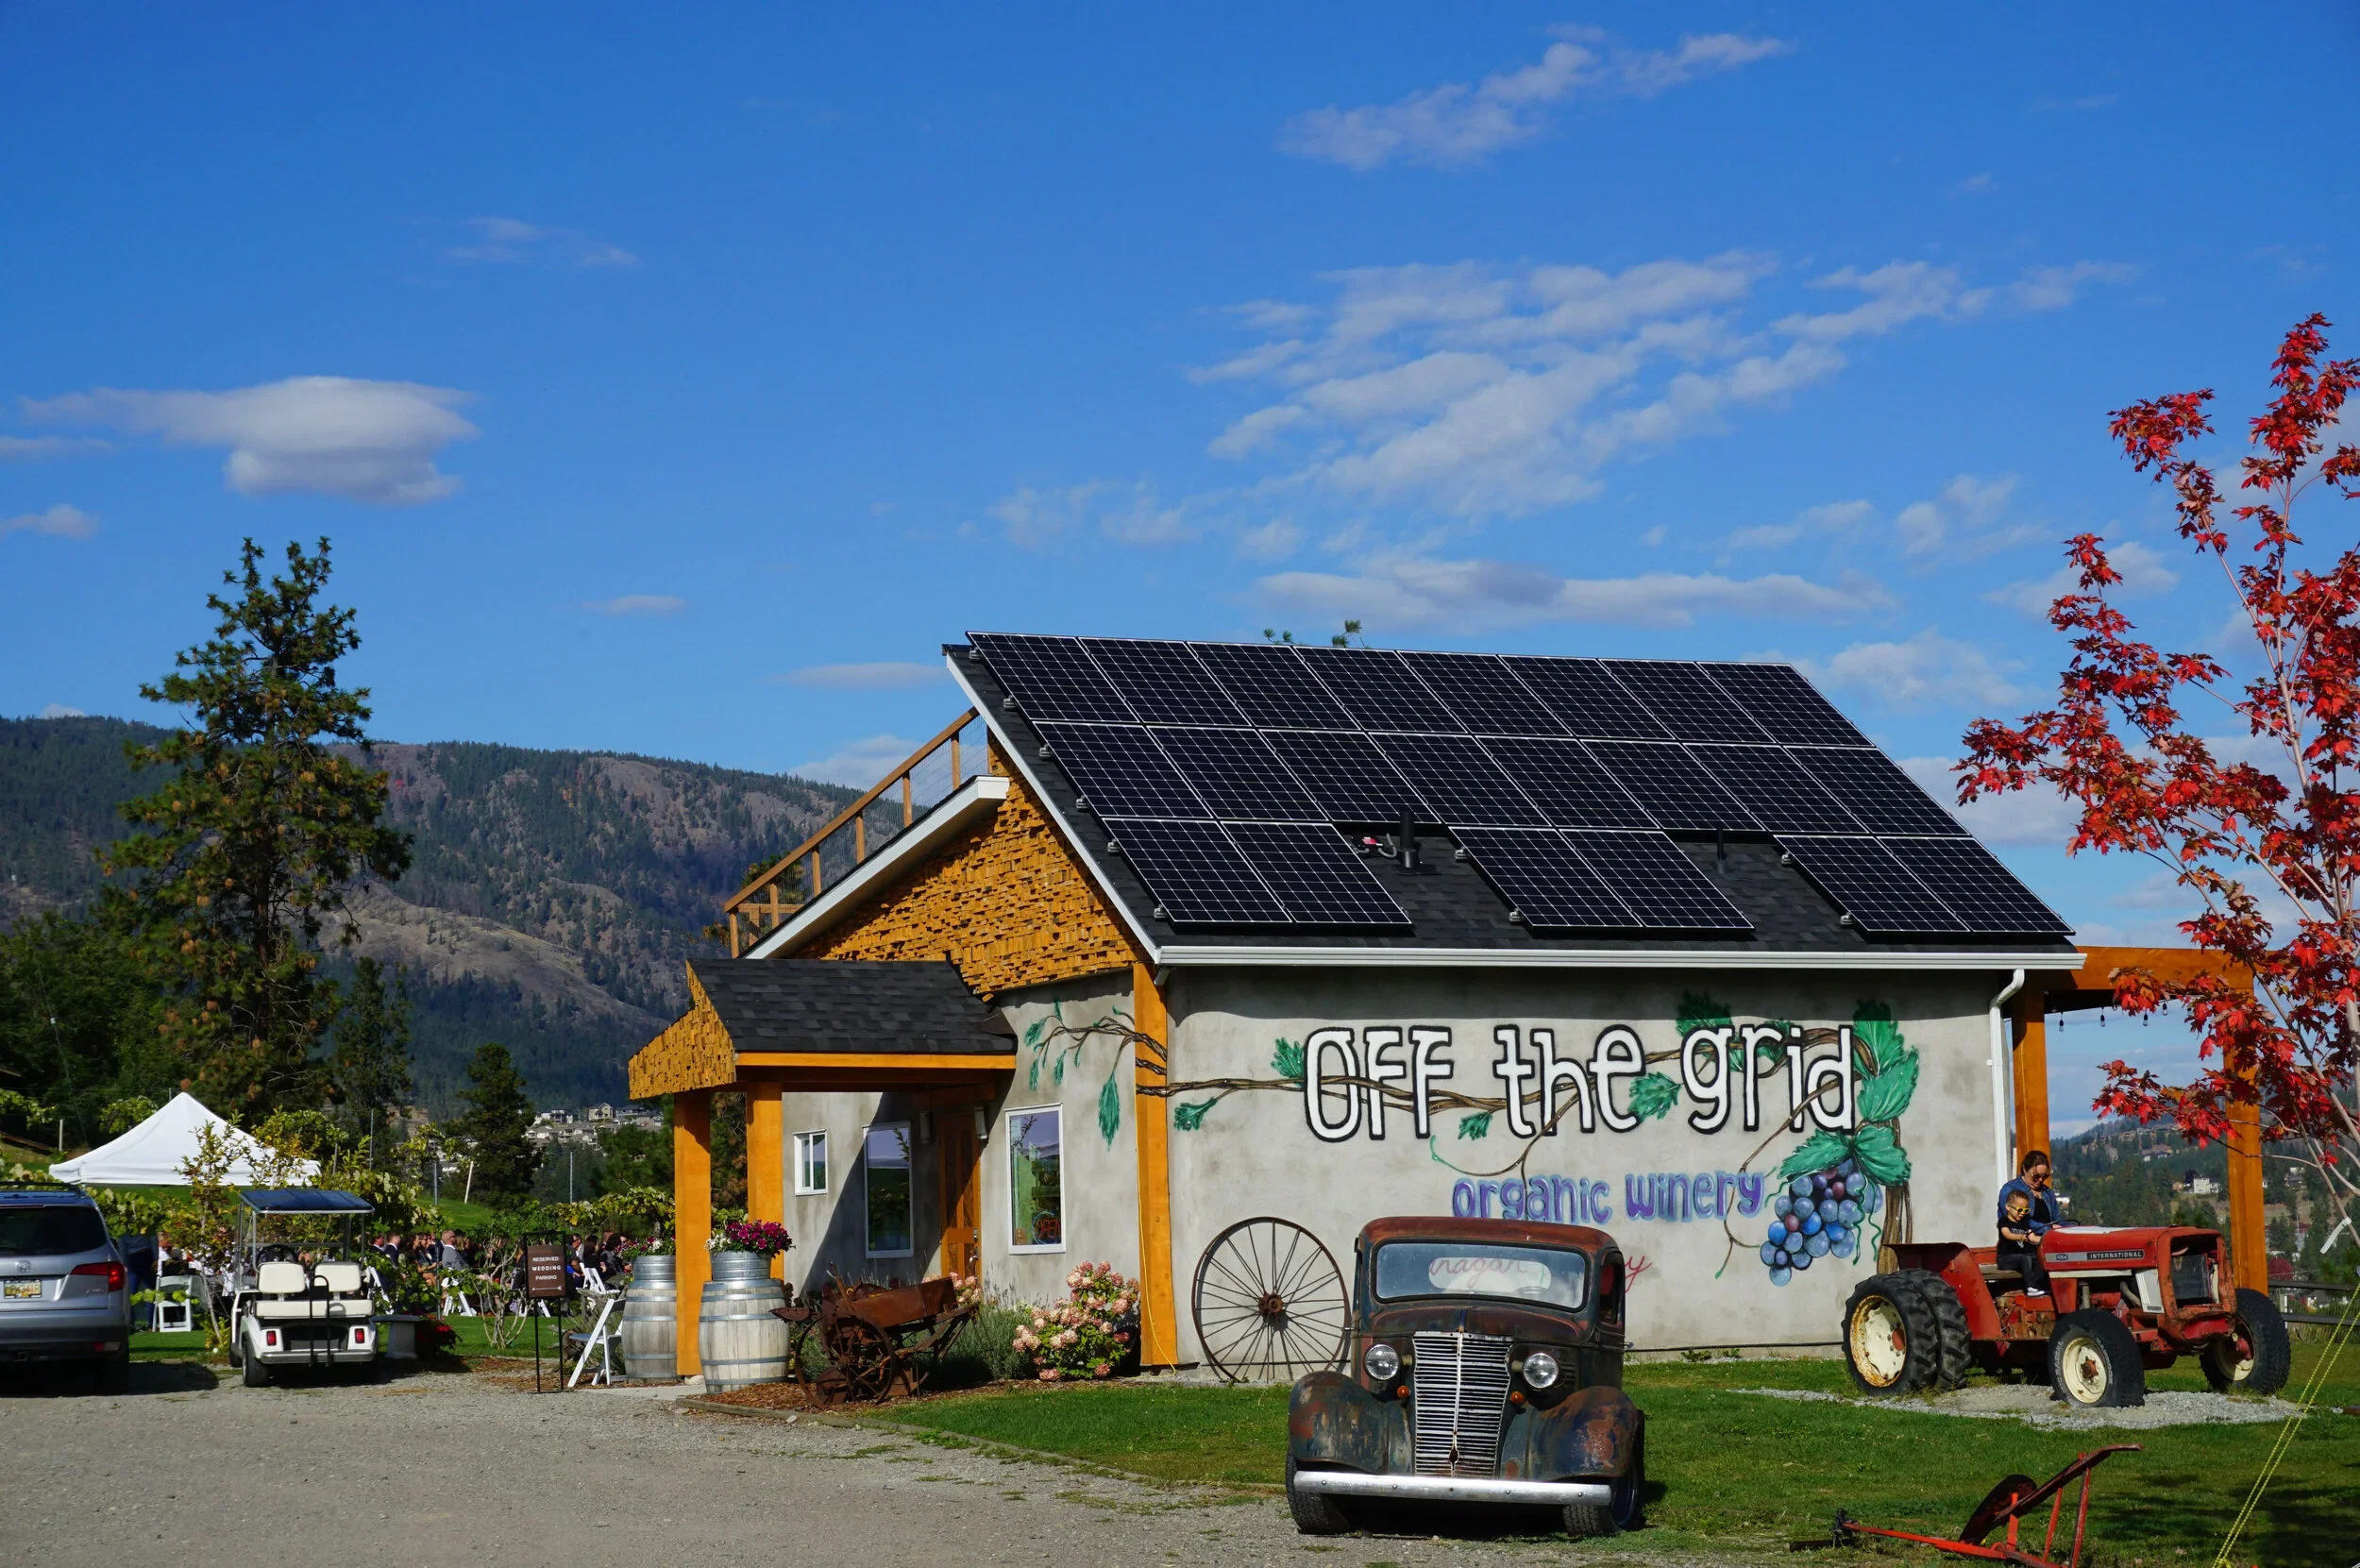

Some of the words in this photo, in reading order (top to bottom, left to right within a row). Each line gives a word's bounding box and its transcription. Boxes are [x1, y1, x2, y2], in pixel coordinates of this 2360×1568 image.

[1492, 1024, 1647, 1138] the
[1680, 1024, 1856, 1135] grid
[1452, 1174, 1611, 1224] organic
[1624, 1171, 1766, 1222] winery
[2089, 1251, 2142, 1259] INTERNATIONAL
